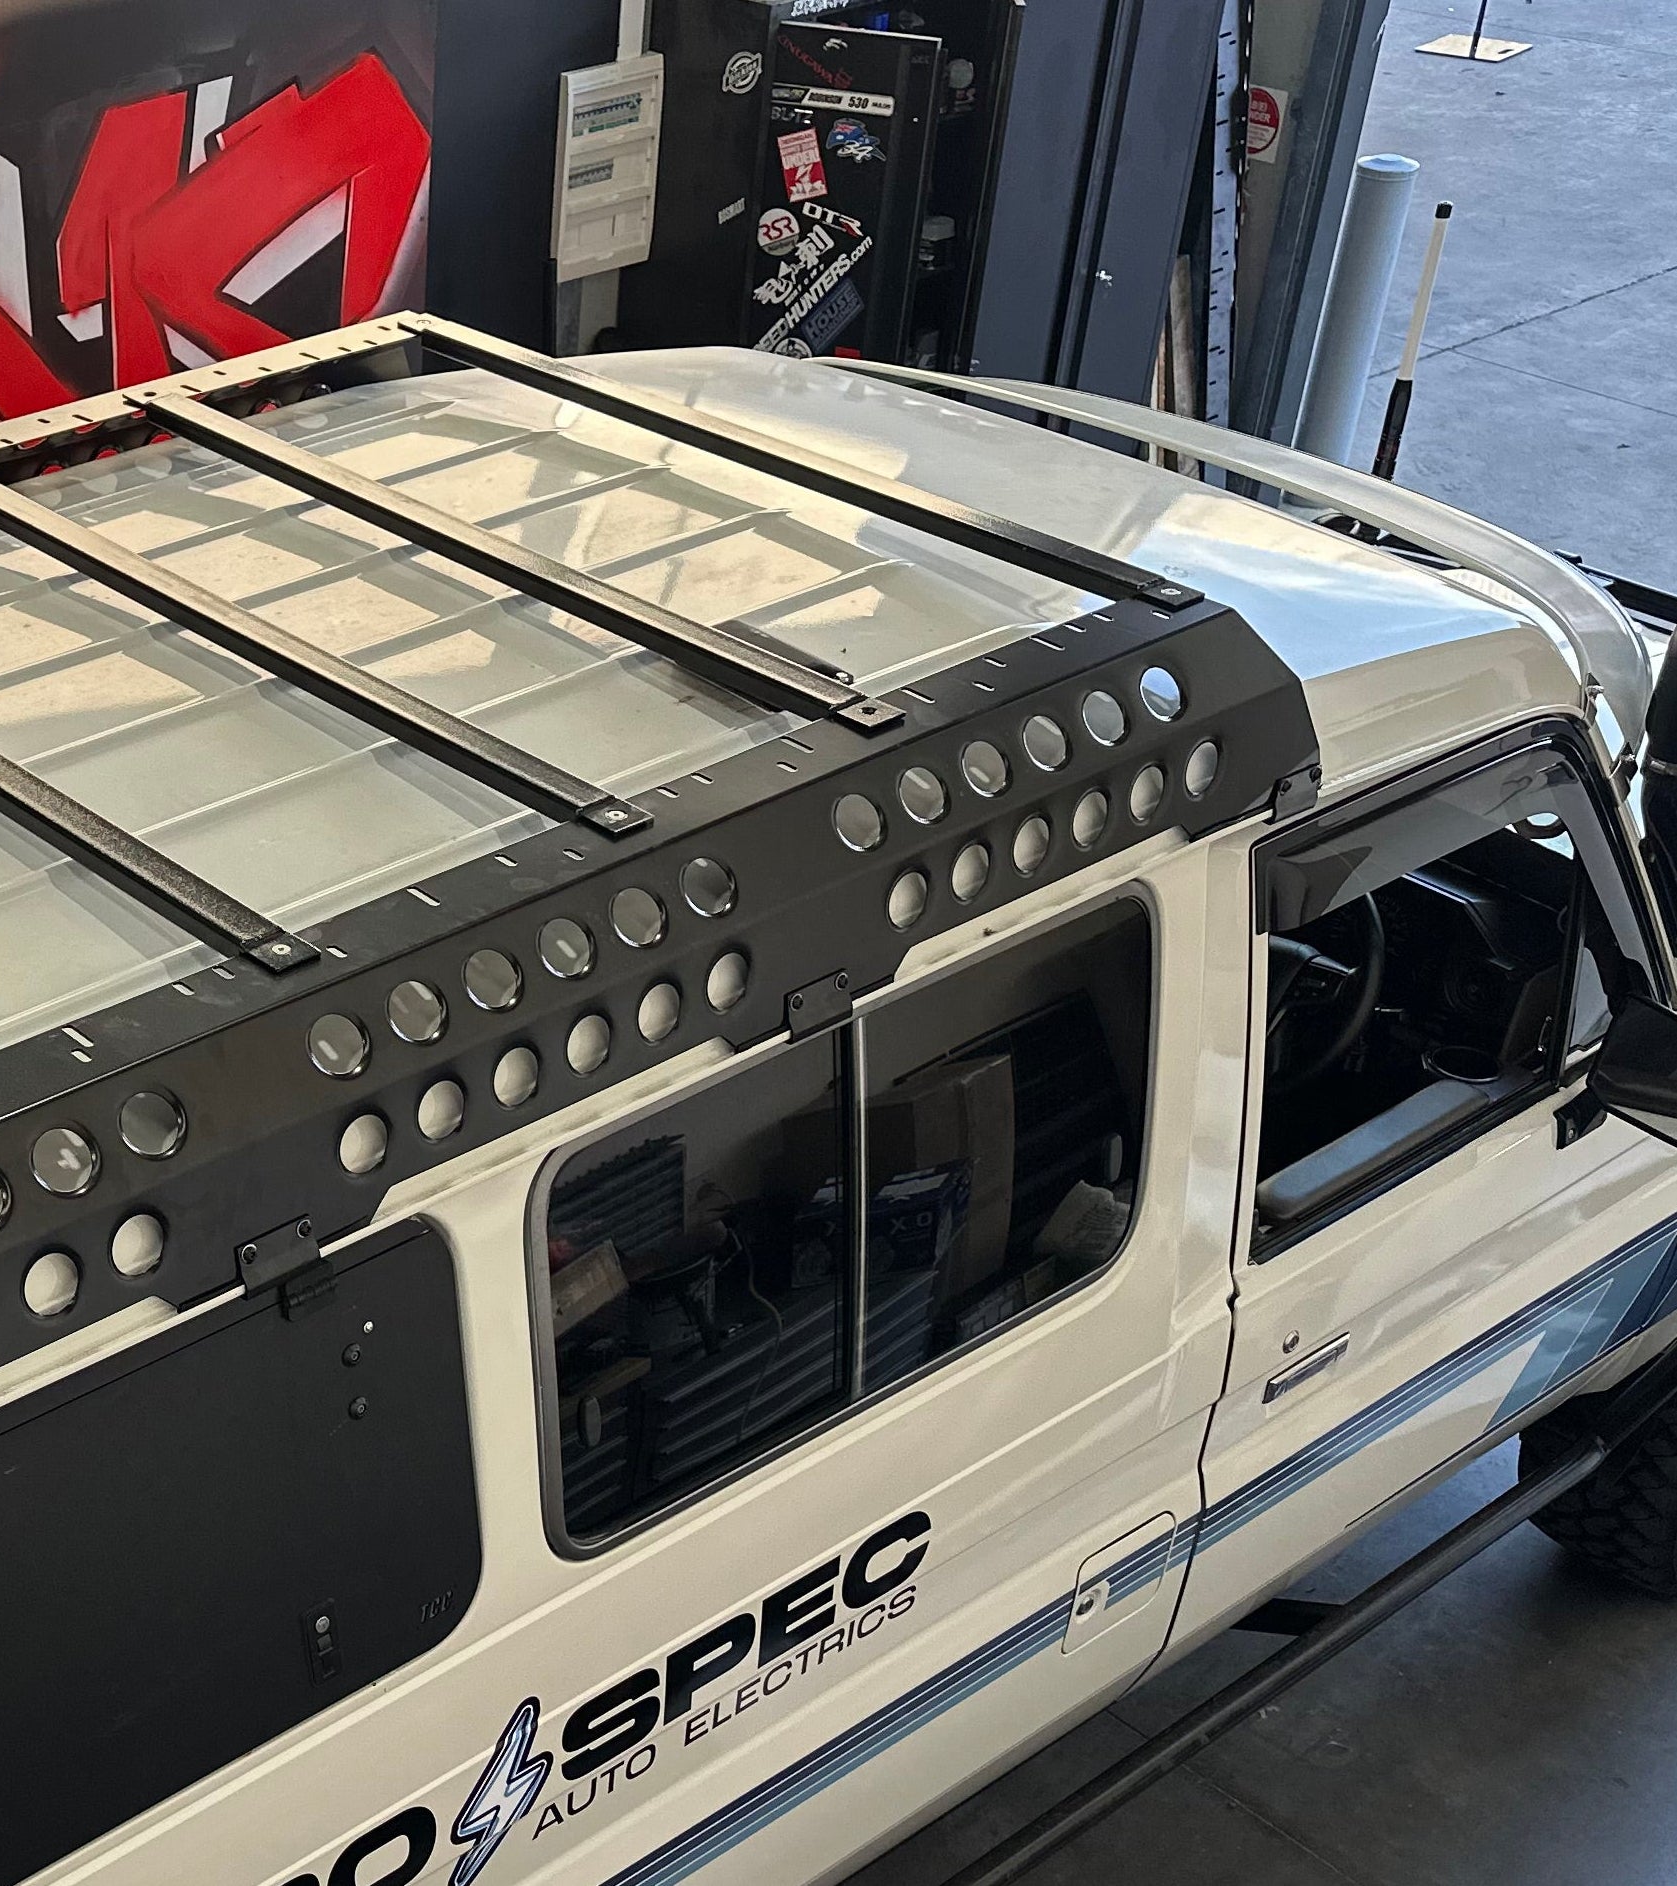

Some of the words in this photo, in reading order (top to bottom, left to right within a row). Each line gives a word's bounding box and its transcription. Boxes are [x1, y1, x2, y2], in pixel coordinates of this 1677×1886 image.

[848, 96, 870, 109] 530
[758, 216, 795, 241] RSR
[533, 1744, 657, 1840] AUTO
[684, 1585, 917, 1747] ELECTRICS
[561, 1511, 932, 1781] SPEC
